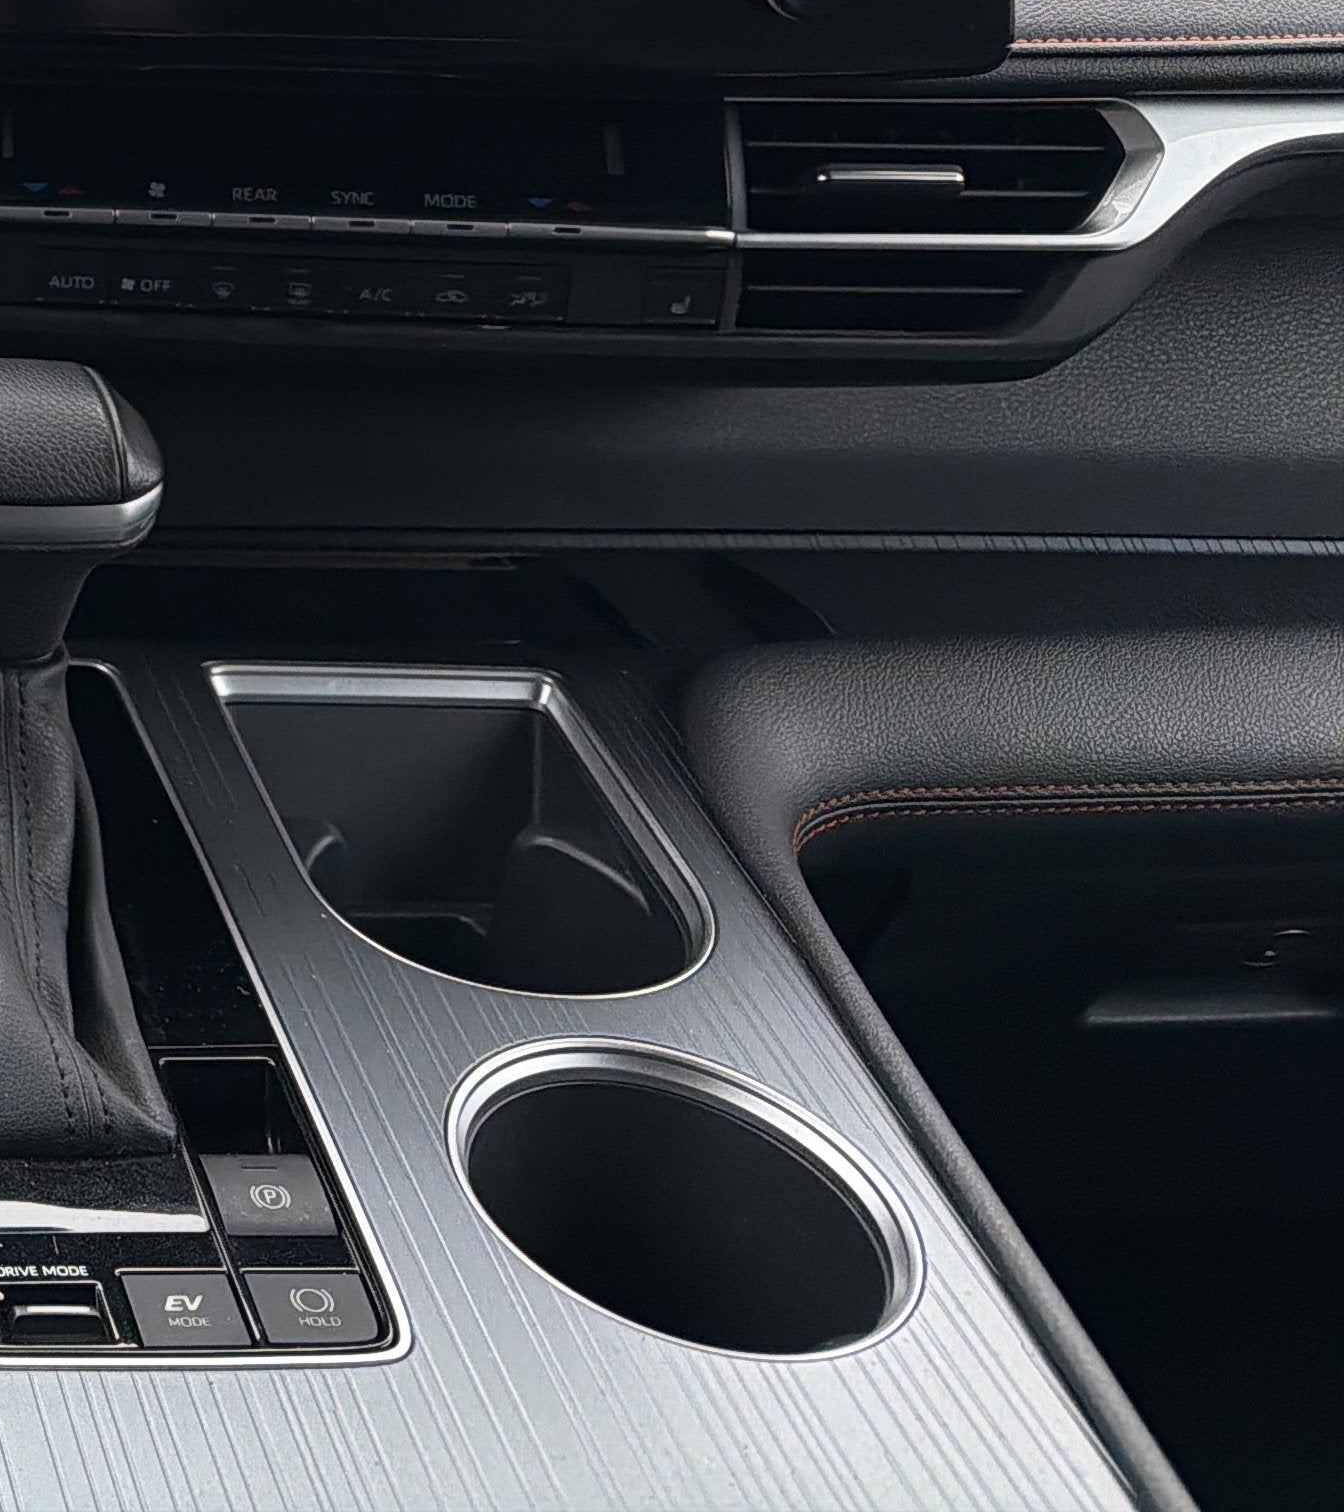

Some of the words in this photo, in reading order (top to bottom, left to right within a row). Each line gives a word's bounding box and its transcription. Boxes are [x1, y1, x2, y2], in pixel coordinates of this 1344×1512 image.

[232, 187, 277, 202] REAR
[331, 191, 374, 206] SYNC
[424, 193, 477, 209] MODE
[49, 275, 95, 289] AUTO
[140, 279, 171, 292] OFF
[359, 288, 392, 302] A/C
[42, 1265, 89, 1278] MODE
[163, 1294, 203, 1312] EV
[168, 1316, 211, 1328] MODE
[298, 1315, 342, 1328] HOLD
